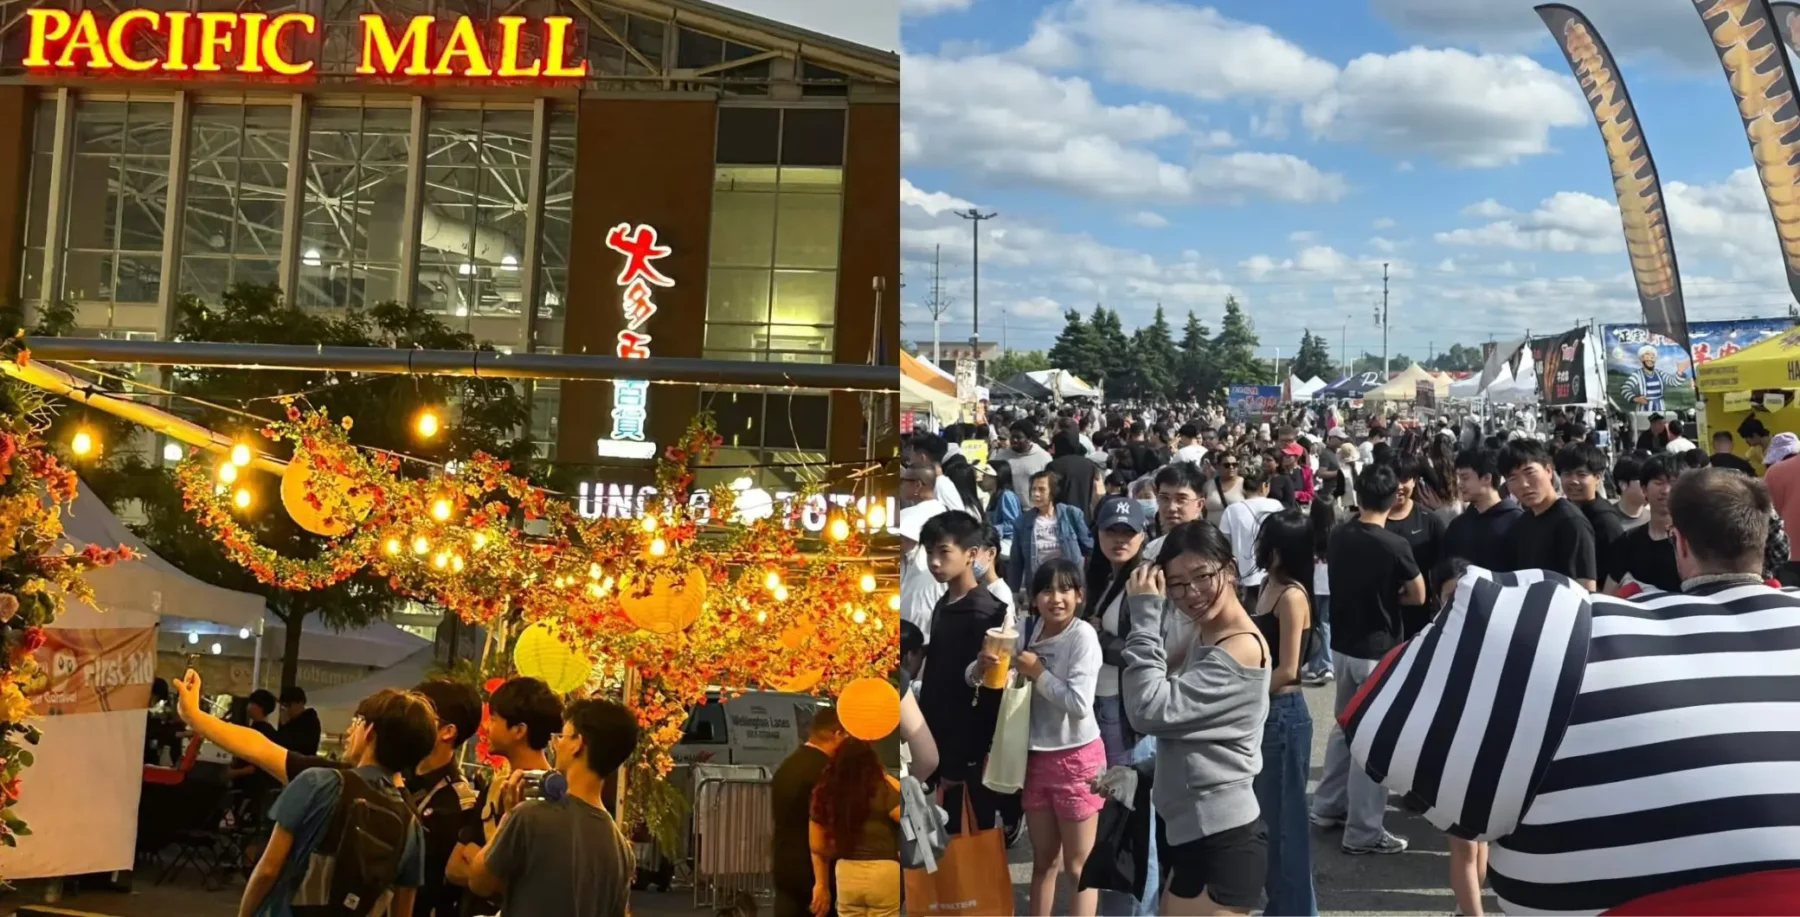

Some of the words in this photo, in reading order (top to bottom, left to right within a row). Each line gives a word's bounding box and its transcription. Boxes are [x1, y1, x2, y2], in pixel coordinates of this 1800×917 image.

[22, 8, 315, 74] PACIFIC
[356, 14, 587, 76] MALL
[83, 652, 127, 688] First
[128, 649, 154, 684] Aid
